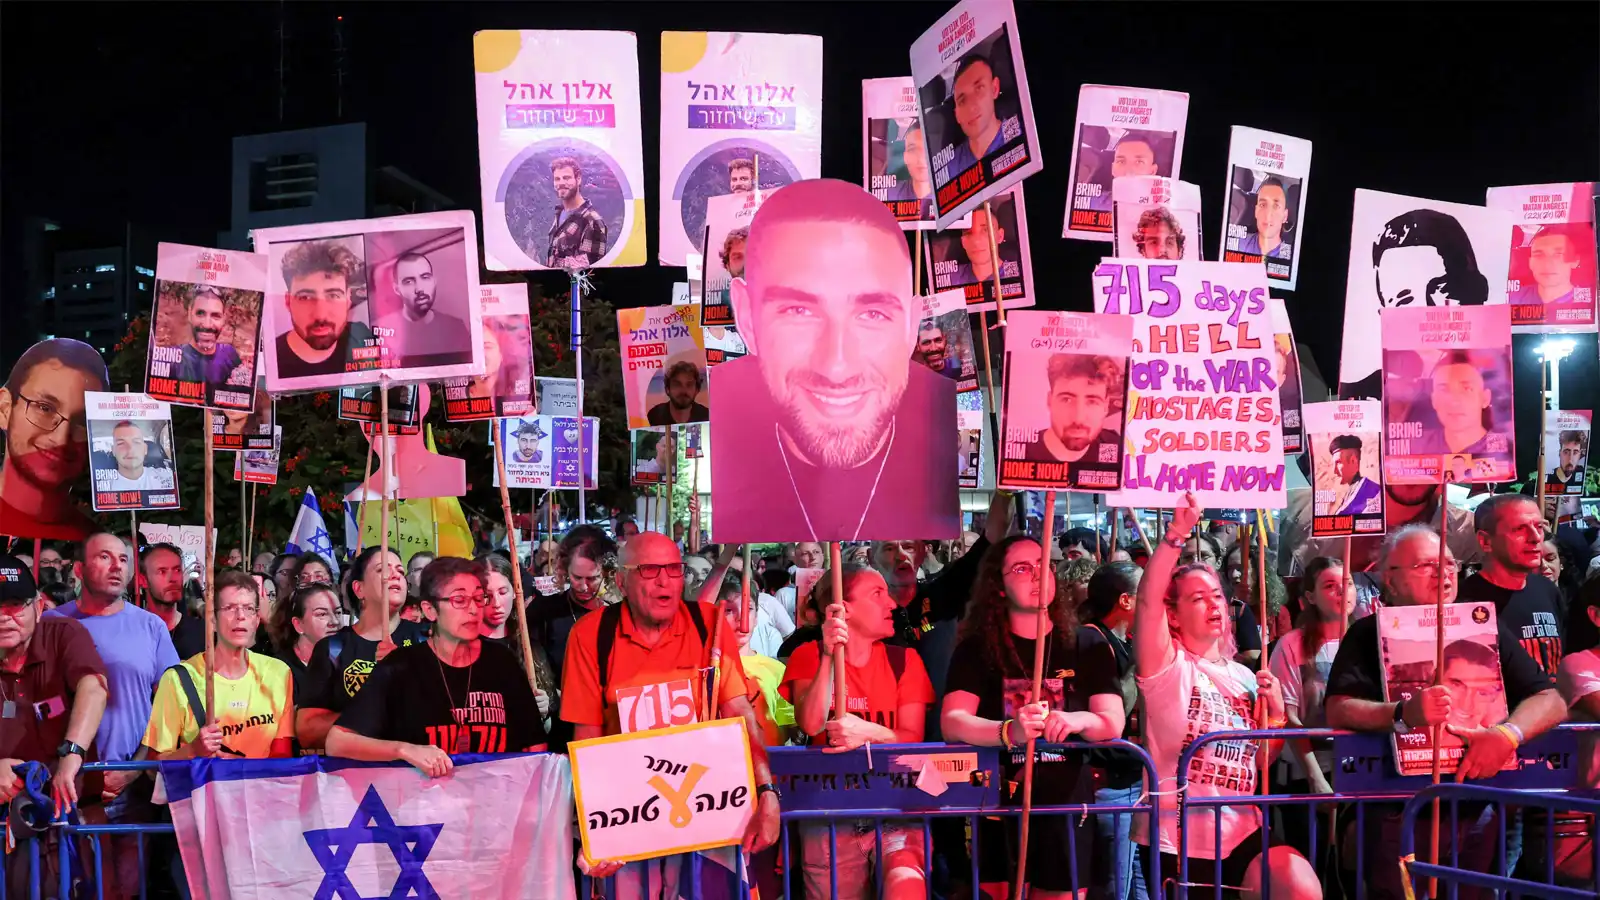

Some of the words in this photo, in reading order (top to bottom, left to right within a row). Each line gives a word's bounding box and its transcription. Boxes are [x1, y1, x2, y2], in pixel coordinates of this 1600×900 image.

[503, 80, 553, 101] אהל
[563, 80, 613, 104] אלון
[687, 81, 736, 101] אהל
[744, 82, 796, 104] אלון
[516, 108, 578, 123] שיחזור
[586, 108, 606, 123] עד
[698, 108, 757, 124] שיחזור
[763, 109, 787, 125] עד
[932, 144, 955, 170] BRING
[872, 175, 897, 189] BRING
[935, 165, 950, 190] HIM
[937, 179, 960, 207] HOME
[960, 161, 985, 193] NOW!
[872, 189, 888, 202] HIM
[1075, 182, 1102, 197] BRING
[898, 200, 921, 215] NOW!
[1074, 196, 1091, 209] HIM
[1072, 211, 1097, 225] HOME
[1098, 213, 1112, 226] NO
[1228, 223, 1248, 239] BRING
[1226, 237, 1240, 251] HIM
[1225, 251, 1245, 263] HOME
[213, 262, 230, 273] ADAR
[934, 260, 958, 275] BRING
[706, 280, 731, 292] BRING
[936, 274, 952, 288] HIM
[705, 292, 722, 305] HIM
[1095, 264, 1181, 318] 715
[1195, 281, 1266, 327] days
[704, 306, 730, 320] HOME
[1520, 305, 1547, 319] NOW!
[648, 317, 661, 325] את
[630, 328, 658, 342] אהל
[661, 325, 690, 343] אלון
[1132, 338, 1143, 353] n
[1149, 321, 1262, 354] HELL
[152, 346, 182, 363] BRING
[630, 344, 666, 357] הביתה
[150, 361, 171, 378] HIM
[629, 358, 663, 371] בחיים
[1131, 358, 1169, 390] OP
[1173, 364, 1206, 392] the
[1203, 357, 1277, 393] WAR
[149, 378, 177, 394] HOME
[178, 380, 206, 398] NOW!
[342, 399, 359, 412] HOME
[447, 400, 470, 413] HOME
[471, 398, 495, 412] NOW!
[553, 400, 577, 408] הביתה
[1134, 396, 1281, 426] HOSTAGES,
[212, 415, 225, 424] RING
[1006, 426, 1039, 443] BRING
[1388, 422, 1422, 438] BRING
[213, 434, 224, 444] OME
[225, 434, 243, 444] NOW!
[1142, 428, 1271, 453] SOLDIERS
[1005, 442, 1026, 459] HIM
[1389, 439, 1411, 455] HIM
[95, 469, 118, 480] BRING
[507, 468, 524, 476] לחזור
[1003, 461, 1034, 479] HOME
[1037, 462, 1068, 480] NOW!
[1124, 453, 1153, 489] LL
[1154, 461, 1216, 493] HOME
[1220, 464, 1286, 491] NOW
[96, 480, 112, 491] HIM
[515, 476, 542, 484] הביתה
[96, 491, 119, 504] HOME
[119, 490, 142, 502] NOW!
[1316, 490, 1336, 503] BRING
[1315, 503, 1331, 515] HIM
[1314, 516, 1336, 530] HOME
[1337, 515, 1353, 530] NOW!
[1444, 617, 1461, 627] OLDIN
[469, 691, 504, 709] מחזירים
[616, 679, 697, 734] 715
[847, 696, 869, 710] HOME
[483, 707, 506, 724] אותם
[1214, 743, 1241, 761] נקום
[643, 755, 688, 776] יותר
[695, 785, 748, 813] שנה
[588, 794, 660, 830] טובה
